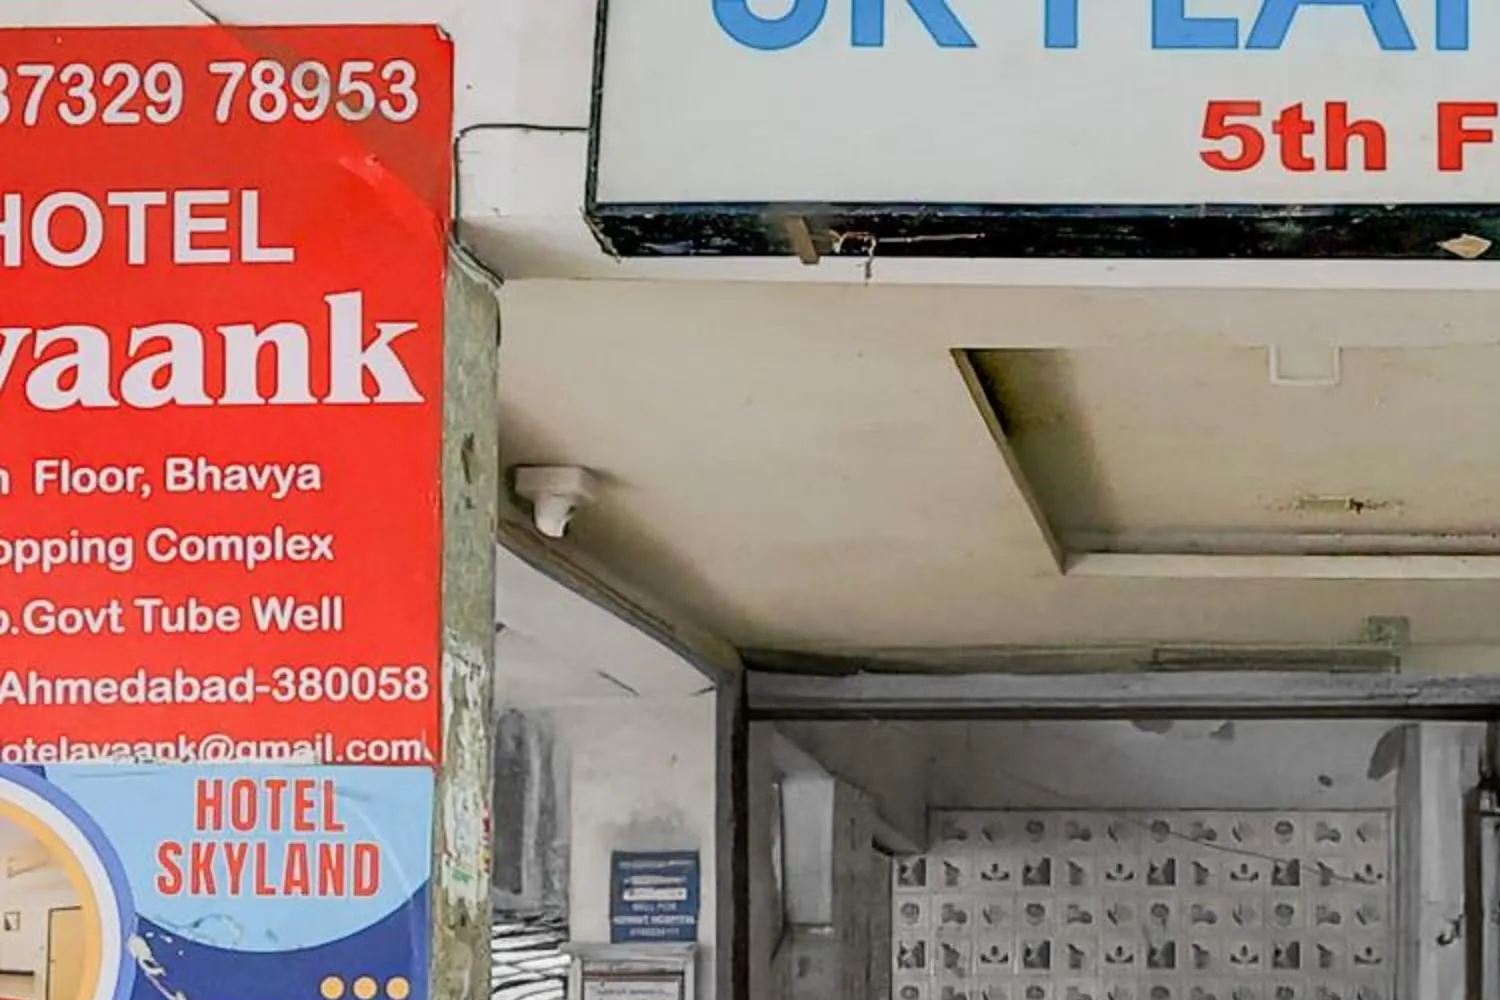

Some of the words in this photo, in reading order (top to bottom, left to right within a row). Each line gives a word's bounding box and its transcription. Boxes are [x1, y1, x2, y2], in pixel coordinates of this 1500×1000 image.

[0, 61, 184, 126] 7329
[209, 59, 419, 123] 78953
[1199, 101, 1387, 171] 5th
[34, 459, 152, 497] Floor,
[166, 457, 322, 498] Bhavya
[146, 526, 334, 571] Complex
[134, 598, 241, 633] Tube
[252, 596, 344, 632] Well
[0, 666, 429, 705] Ahmedabad-380058
[195, 778, 347, 832] HOTEL
[155, 841, 380, 897] SKYLAND
